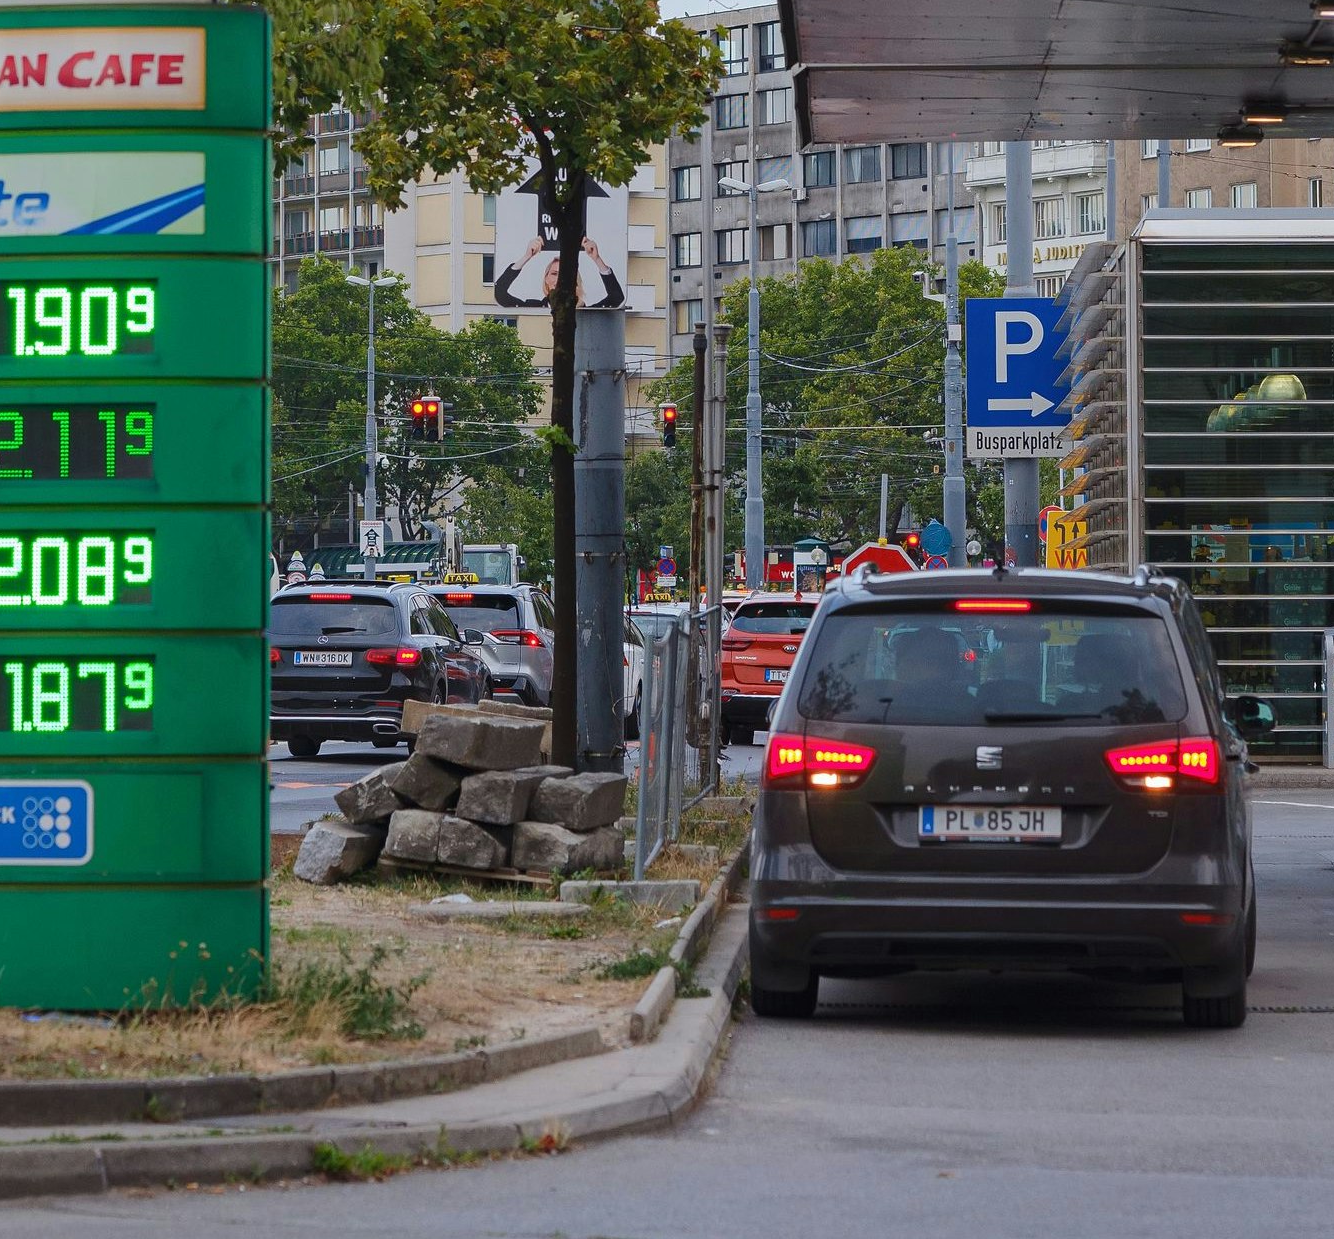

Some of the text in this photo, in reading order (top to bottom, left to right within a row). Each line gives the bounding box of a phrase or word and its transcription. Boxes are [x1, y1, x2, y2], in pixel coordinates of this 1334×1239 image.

[57, 50, 185, 90] CAFE
[995, 311, 1044, 383] P
[976, 431, 1063, 455] Busparkplatz
[449, 575, 474, 583] TAXI
[302, 653, 315, 663] WN
[946, 810, 969, 831] PL
[988, 810, 1013, 831] 85
[1019, 811, 1044, 831] JH
